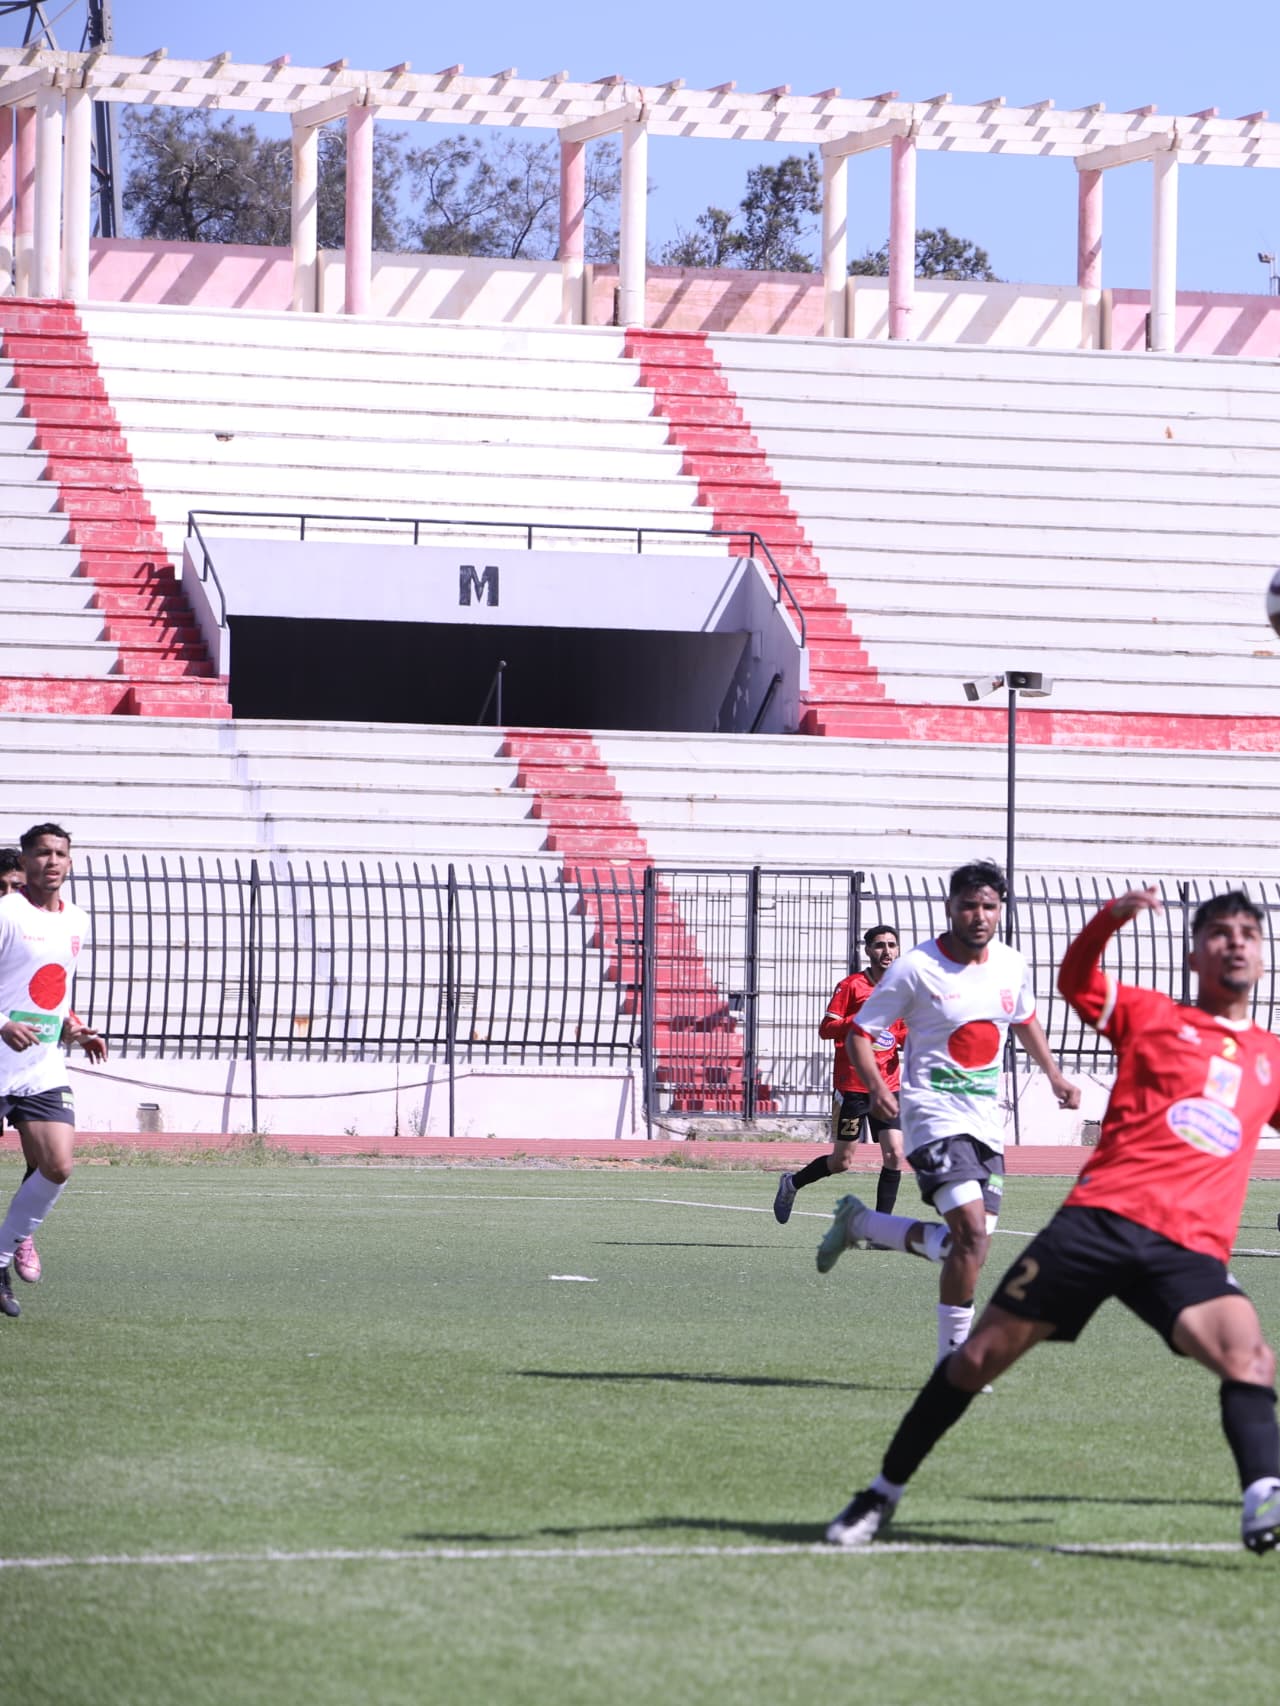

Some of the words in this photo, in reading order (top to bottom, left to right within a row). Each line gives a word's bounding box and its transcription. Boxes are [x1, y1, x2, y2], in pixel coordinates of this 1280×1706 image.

[459, 565, 499, 607] M
[840, 1118, 860, 1136] 23
[1005, 1257, 1040, 1301] 2
